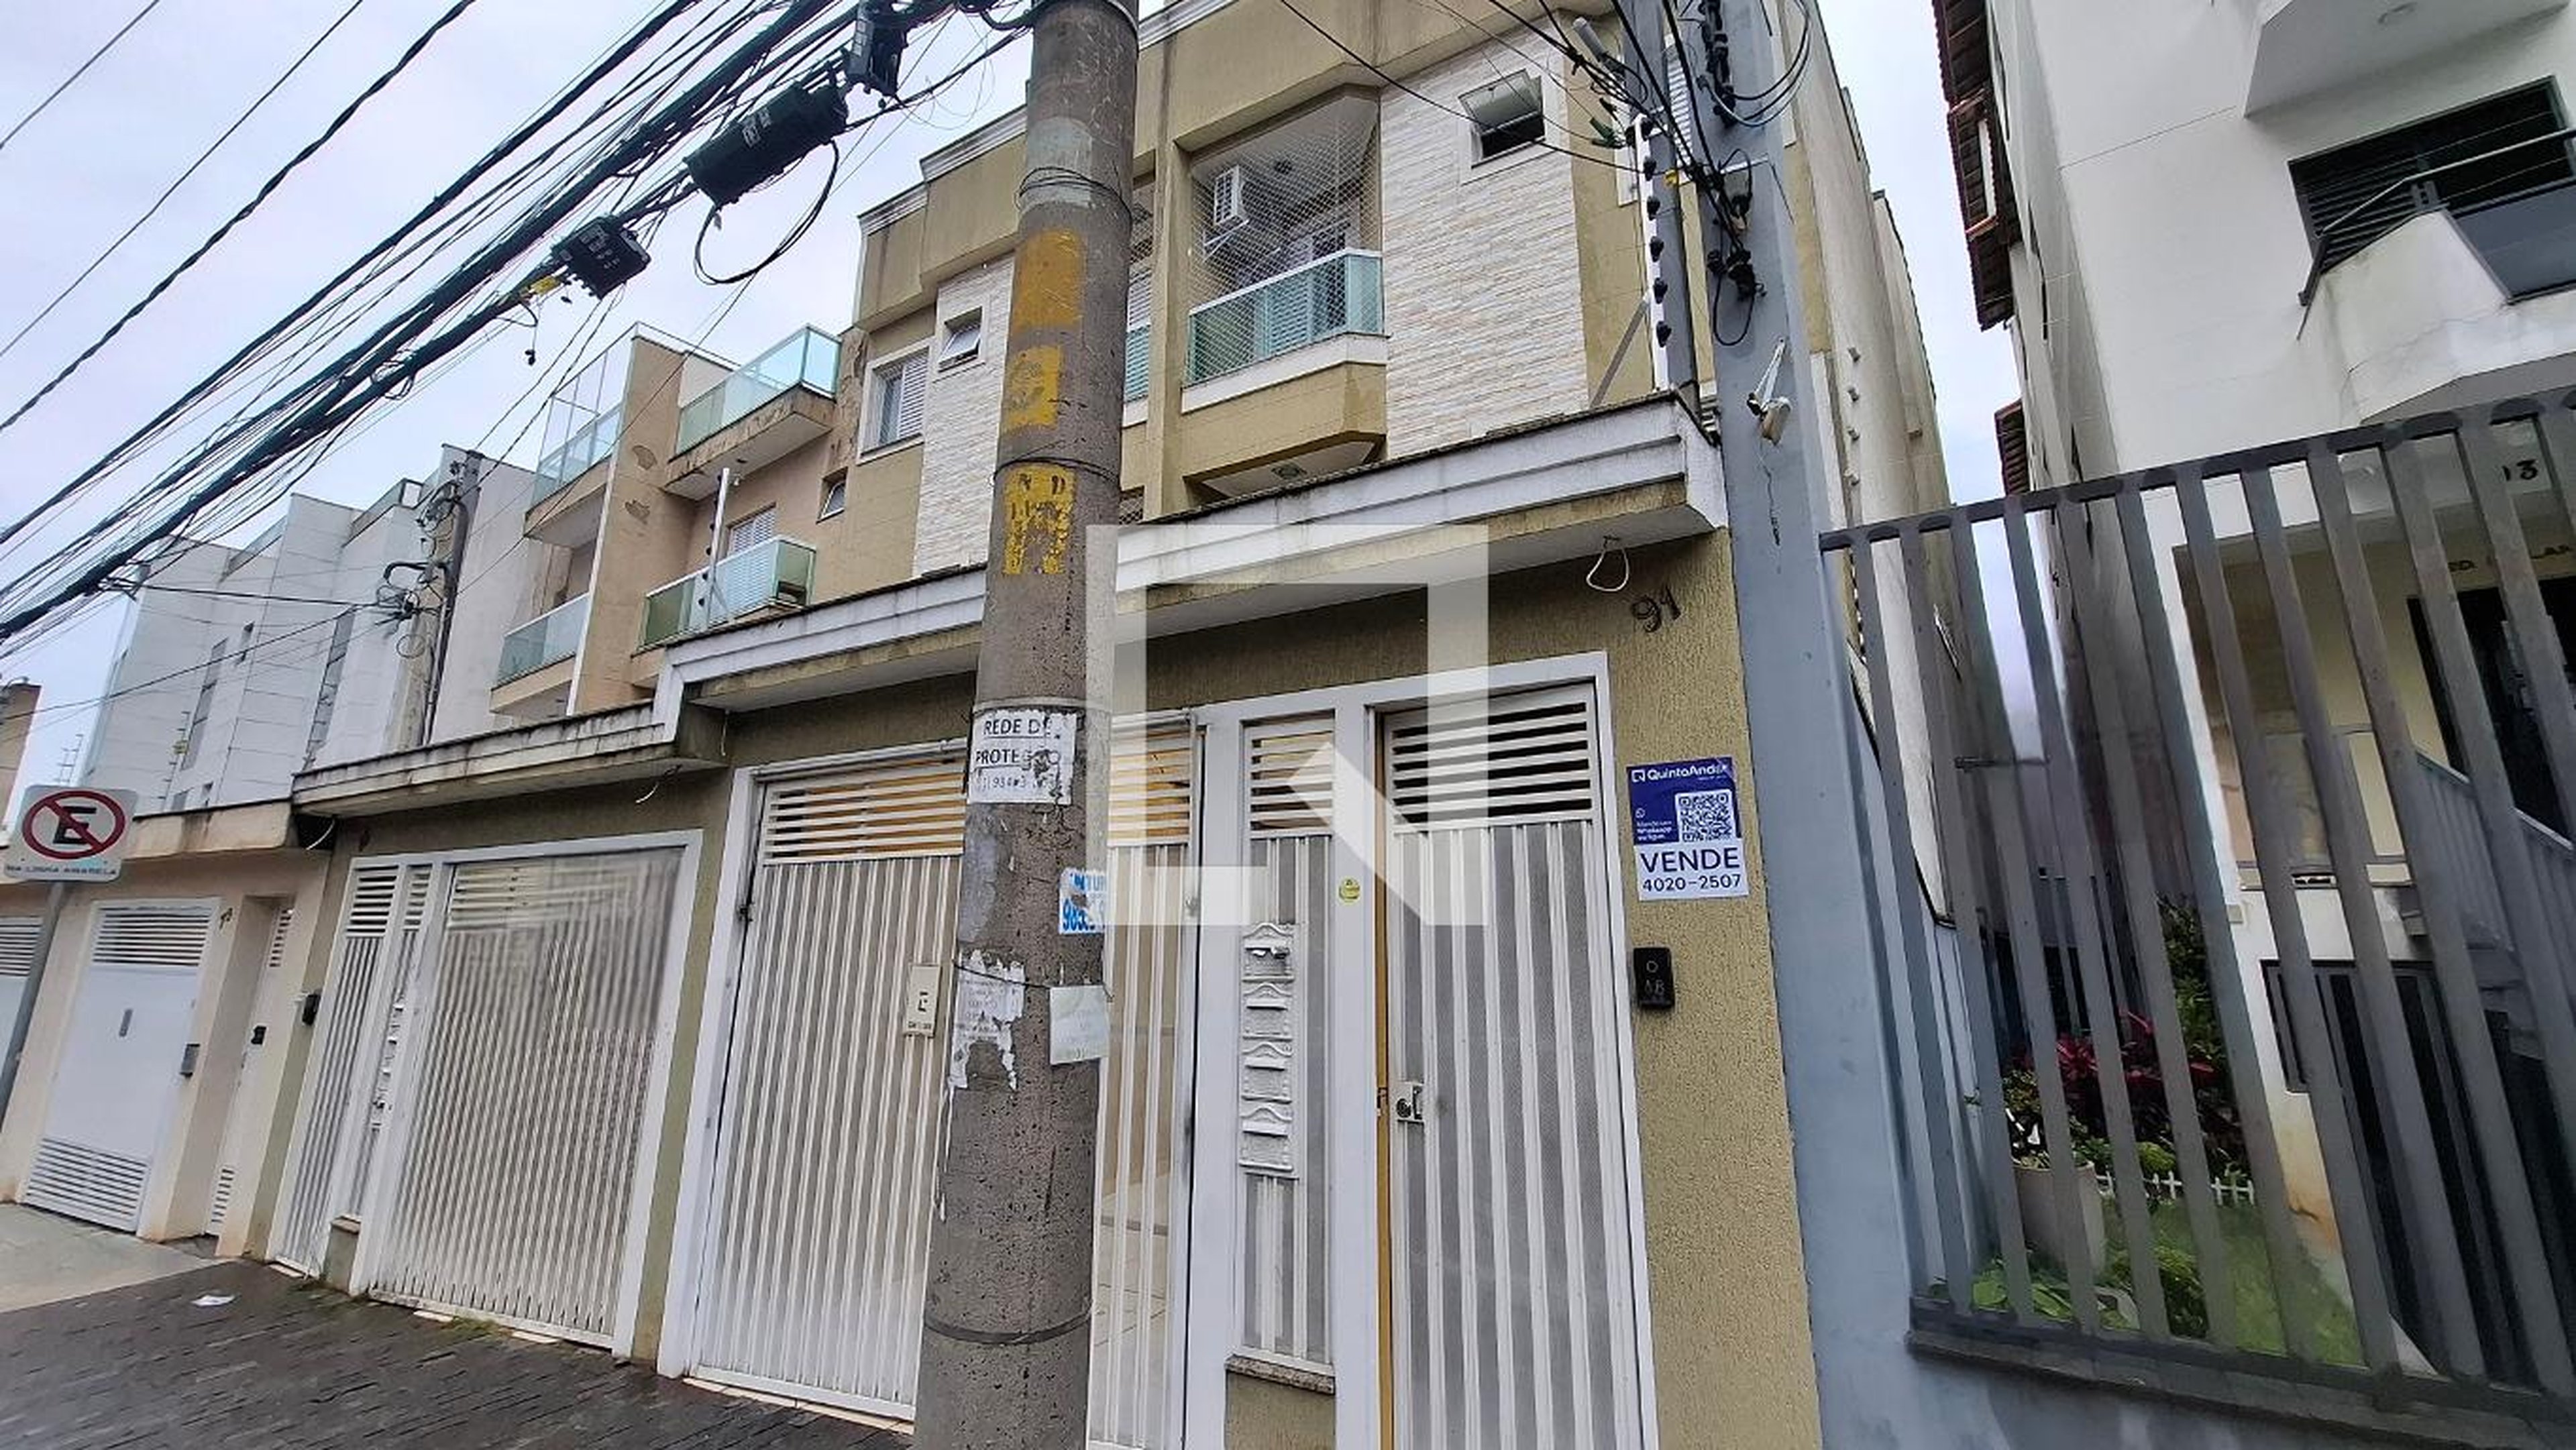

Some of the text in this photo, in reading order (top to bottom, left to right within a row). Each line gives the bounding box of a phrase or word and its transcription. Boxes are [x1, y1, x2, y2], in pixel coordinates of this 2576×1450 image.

[1630, 585, 1681, 632] 91
[983, 718, 1022, 735] REDE
[1640, 847, 1741, 873] VENDE
[1643, 873, 1741, 892] 4020-2507
